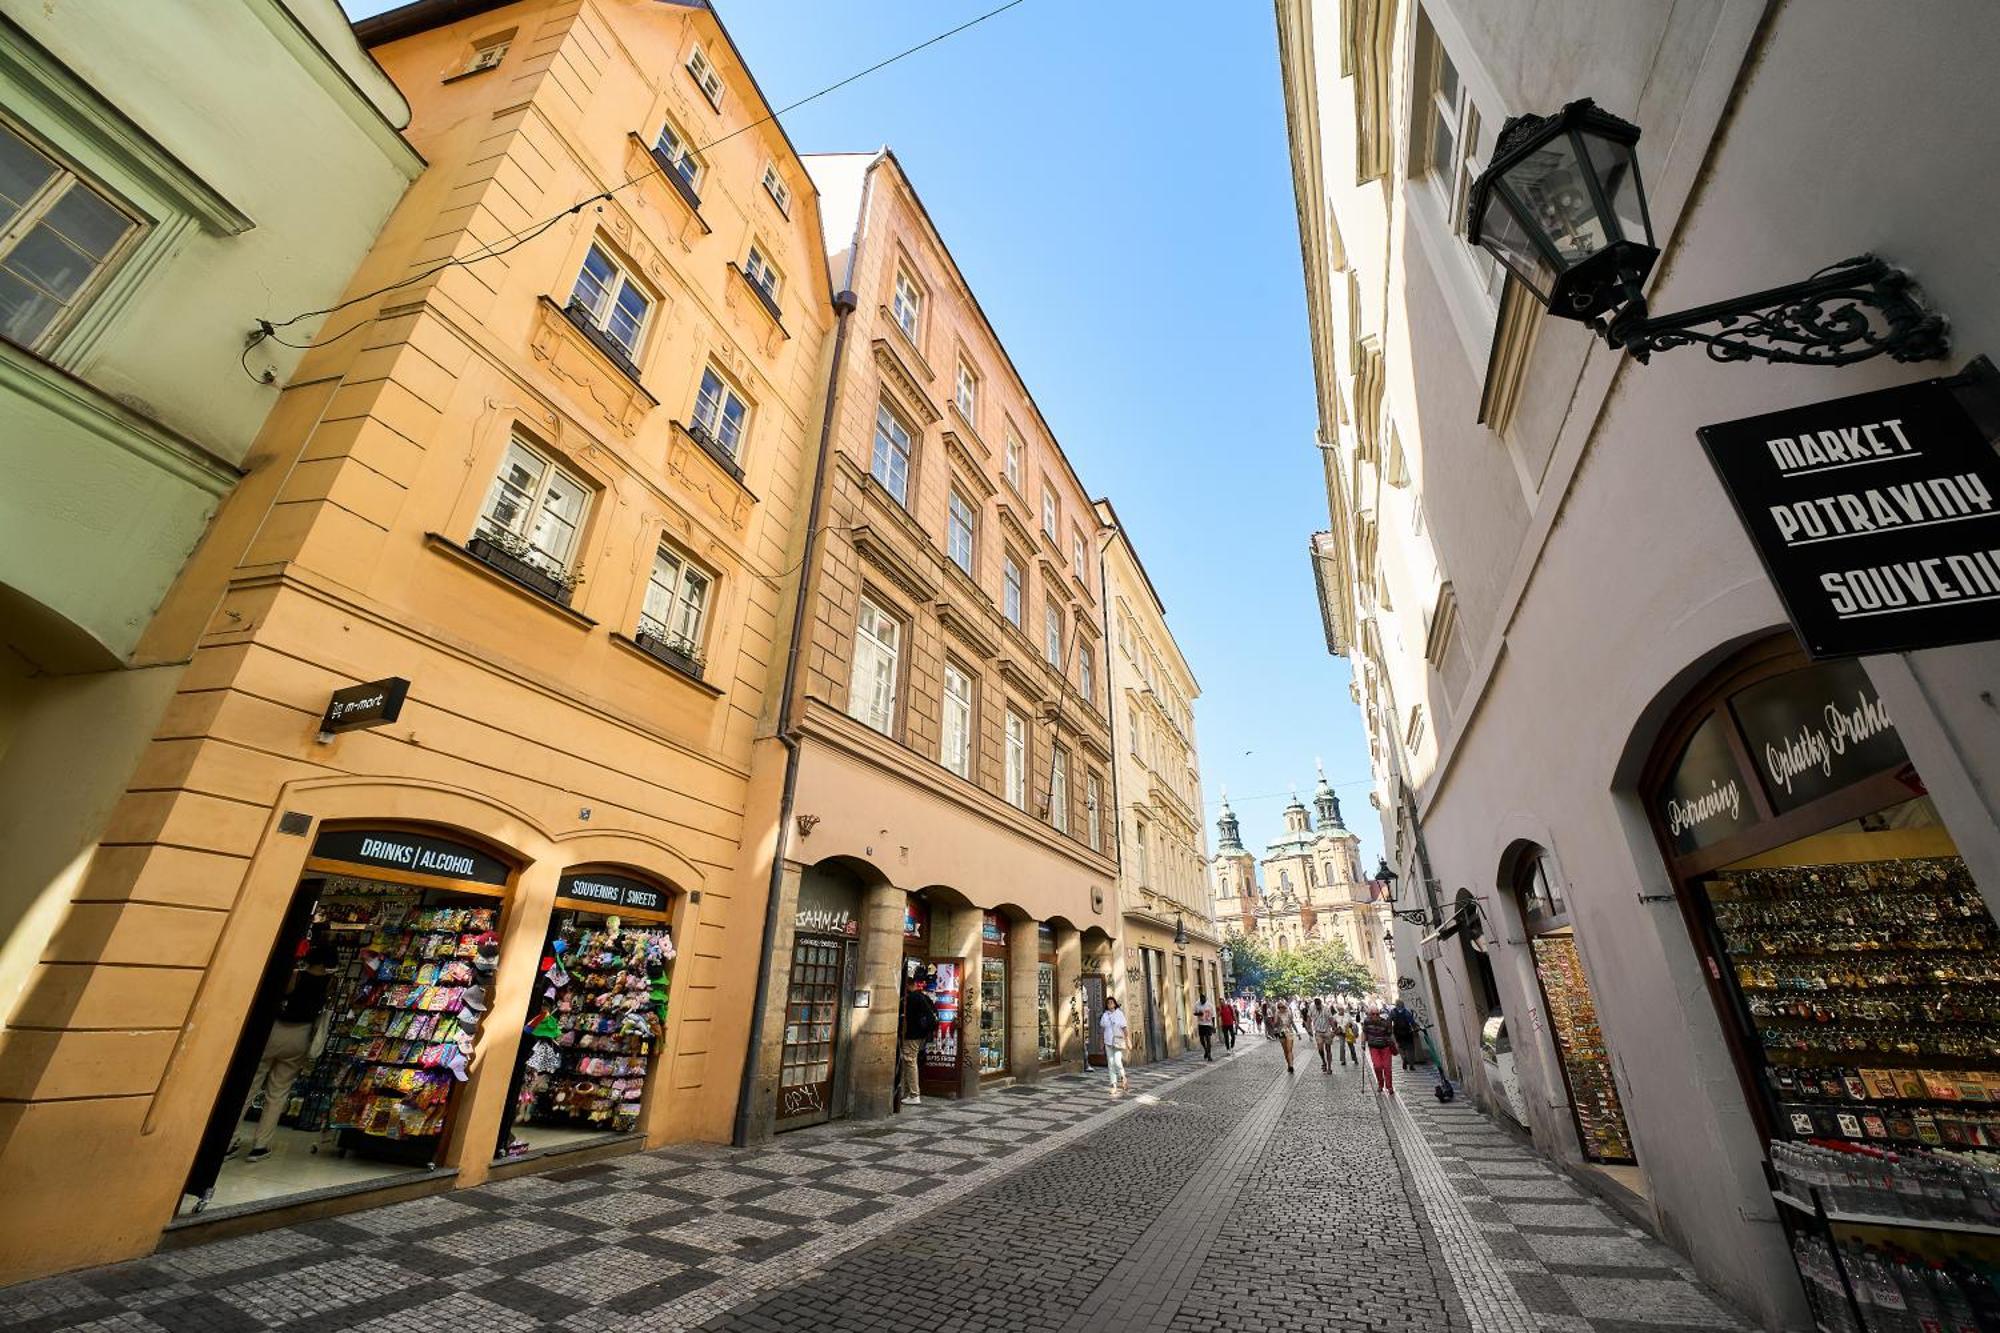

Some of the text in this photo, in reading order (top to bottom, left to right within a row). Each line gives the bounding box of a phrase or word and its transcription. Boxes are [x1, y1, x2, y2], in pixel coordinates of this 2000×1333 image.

[1766, 419, 1913, 470] MARKET
[1768, 472, 1993, 541] POTRAVINY
[344, 693, 383, 713] m-mart
[1766, 725, 1831, 795] Oplatky
[1667, 779, 1740, 837] Potraviny
[360, 838, 475, 876] DRINKS ALCOHOL
[572, 880, 657, 907] SOUVENIRS SWEETS
